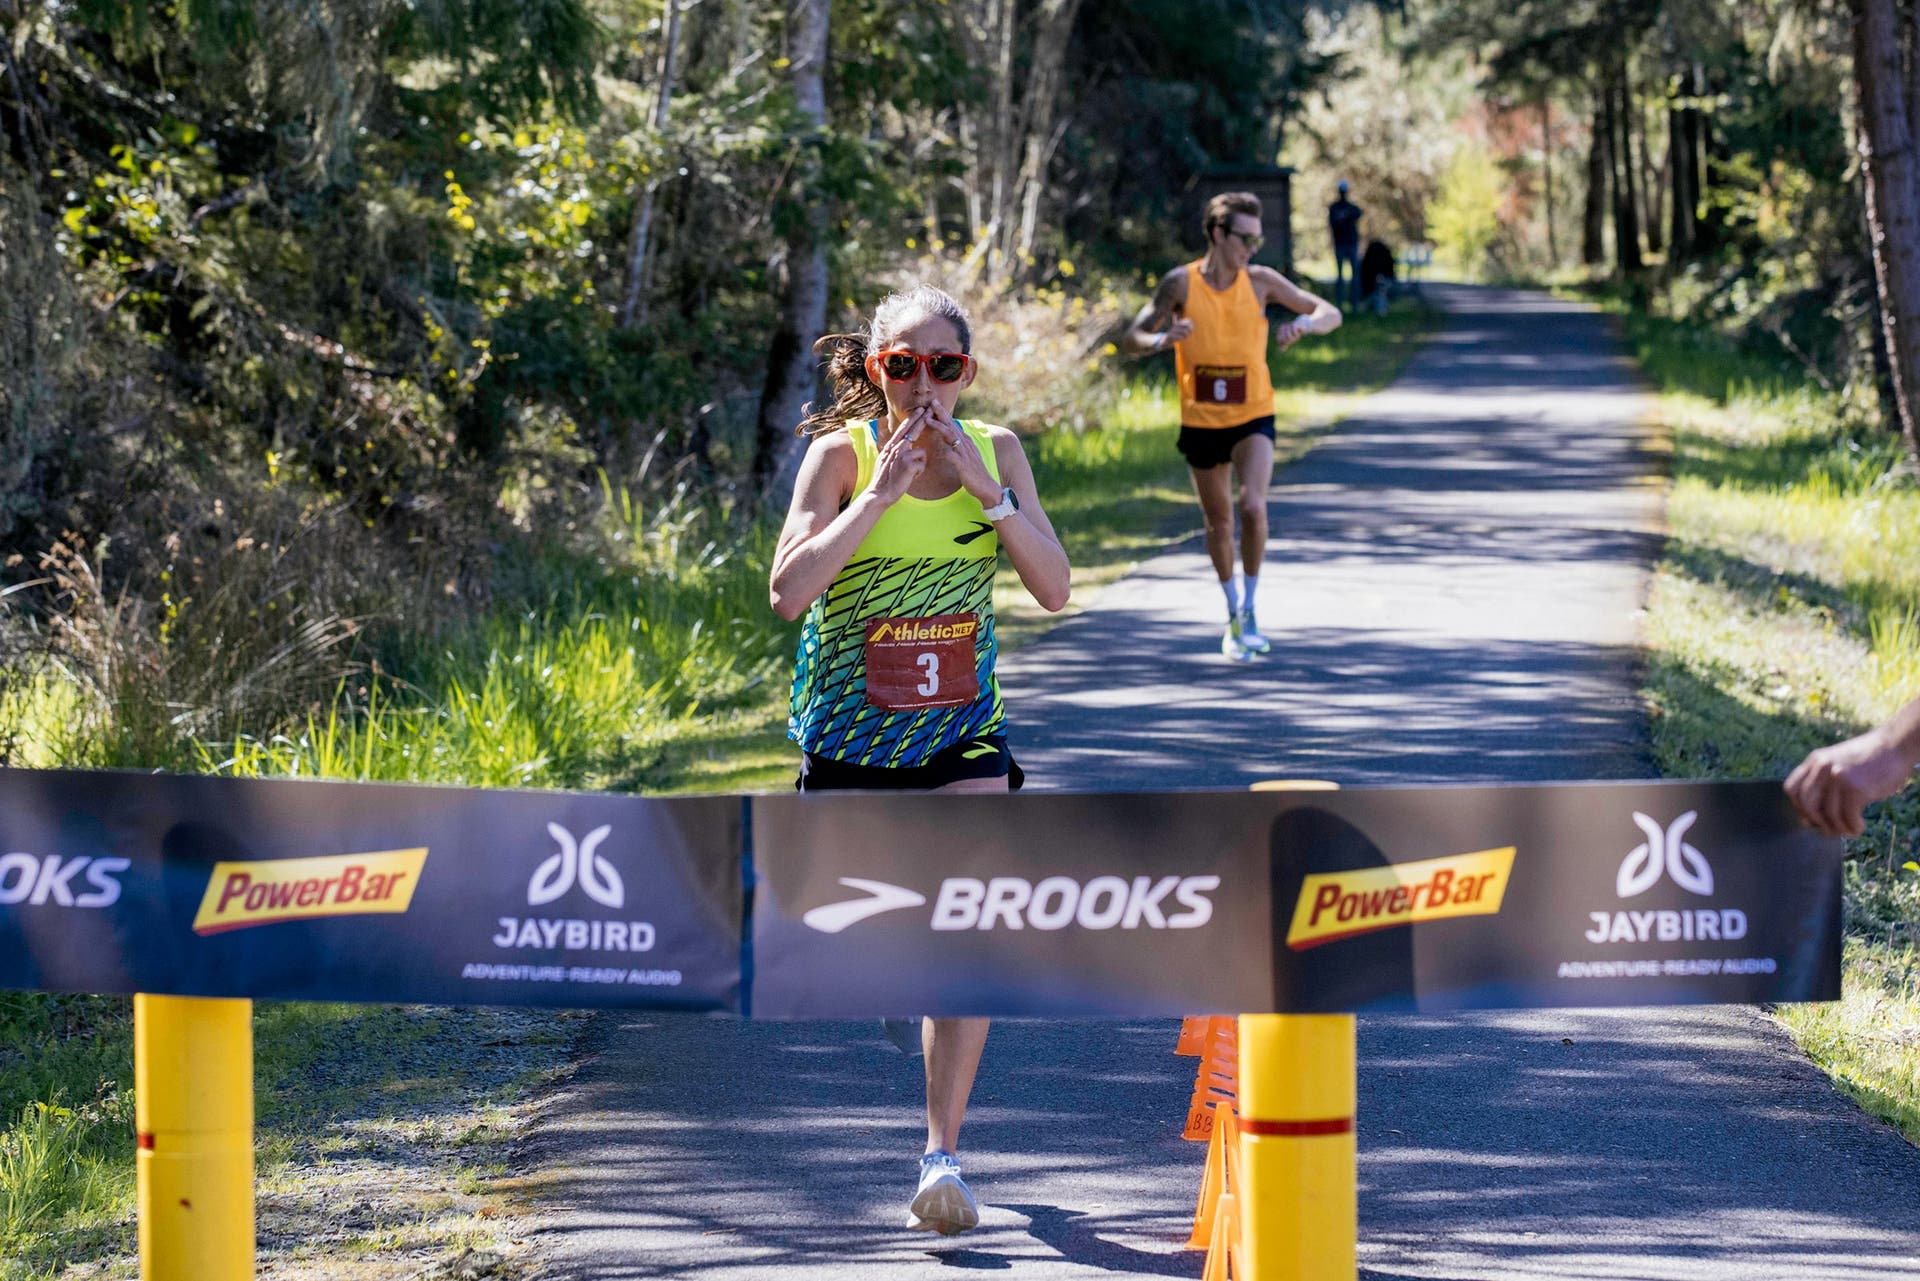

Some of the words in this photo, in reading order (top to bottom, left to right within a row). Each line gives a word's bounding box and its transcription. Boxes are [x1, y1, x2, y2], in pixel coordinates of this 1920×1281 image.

[1213, 379, 1228, 401] 6
[916, 652, 940, 697] 3
[0, 853, 131, 907] OKS
[216, 865, 407, 914] PowerBar
[1308, 869, 1496, 927] PowerBar
[930, 875, 1221, 931] BROOKS
[493, 917, 656, 952] JAYBIRD
[1584, 909, 1748, 943] JAYBIRD
[627, 968, 682, 985] AUDIO
[1721, 958, 1778, 974] AUDIO
